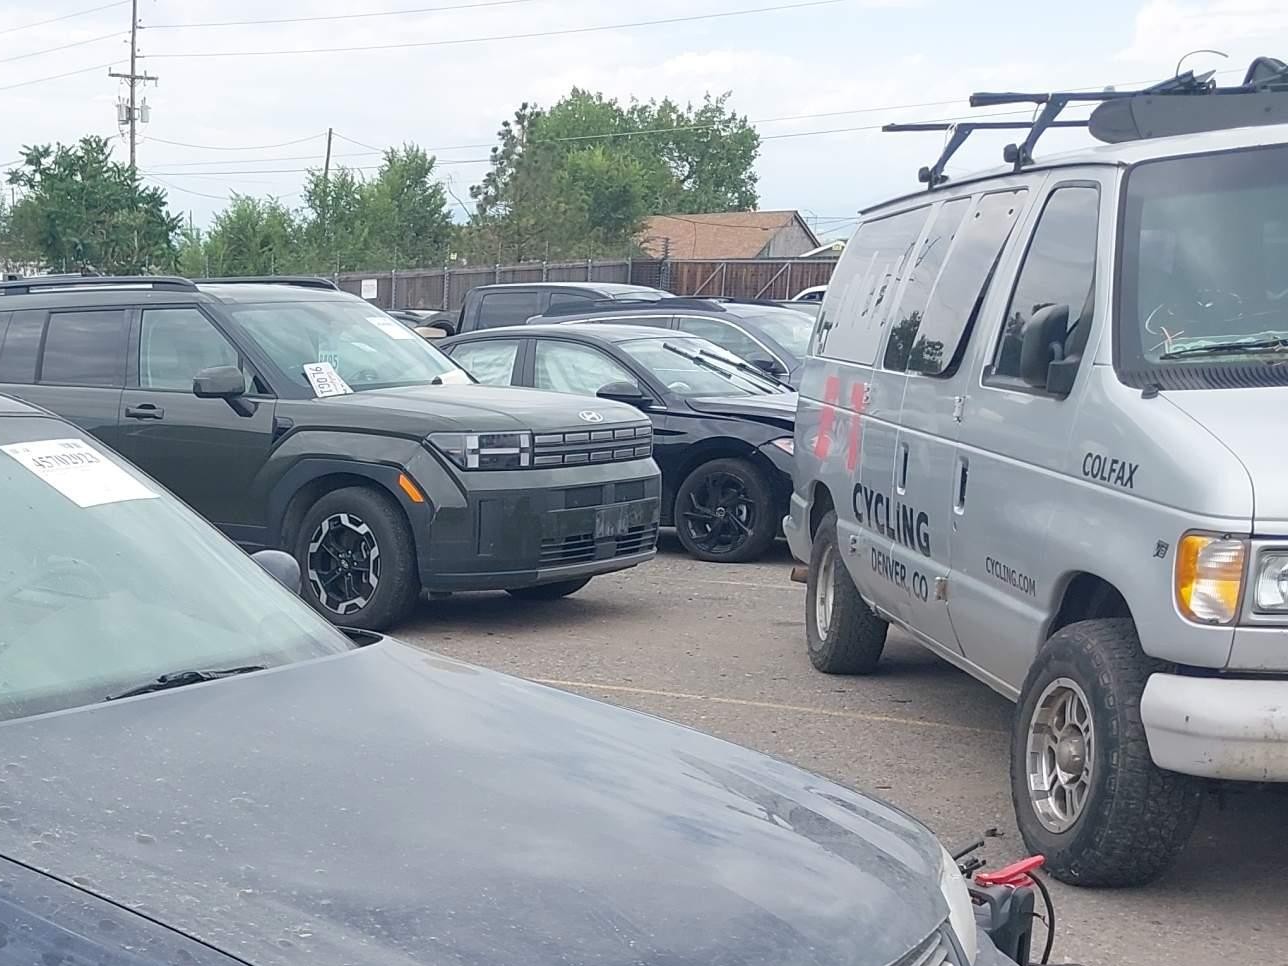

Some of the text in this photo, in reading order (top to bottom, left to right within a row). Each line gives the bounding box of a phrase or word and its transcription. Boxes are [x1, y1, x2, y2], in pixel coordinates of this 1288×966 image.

[1082, 452, 1140, 489] COLFAX
[913, 571, 928, 602] CO
[985, 556, 1036, 597] CYCLING.COM
